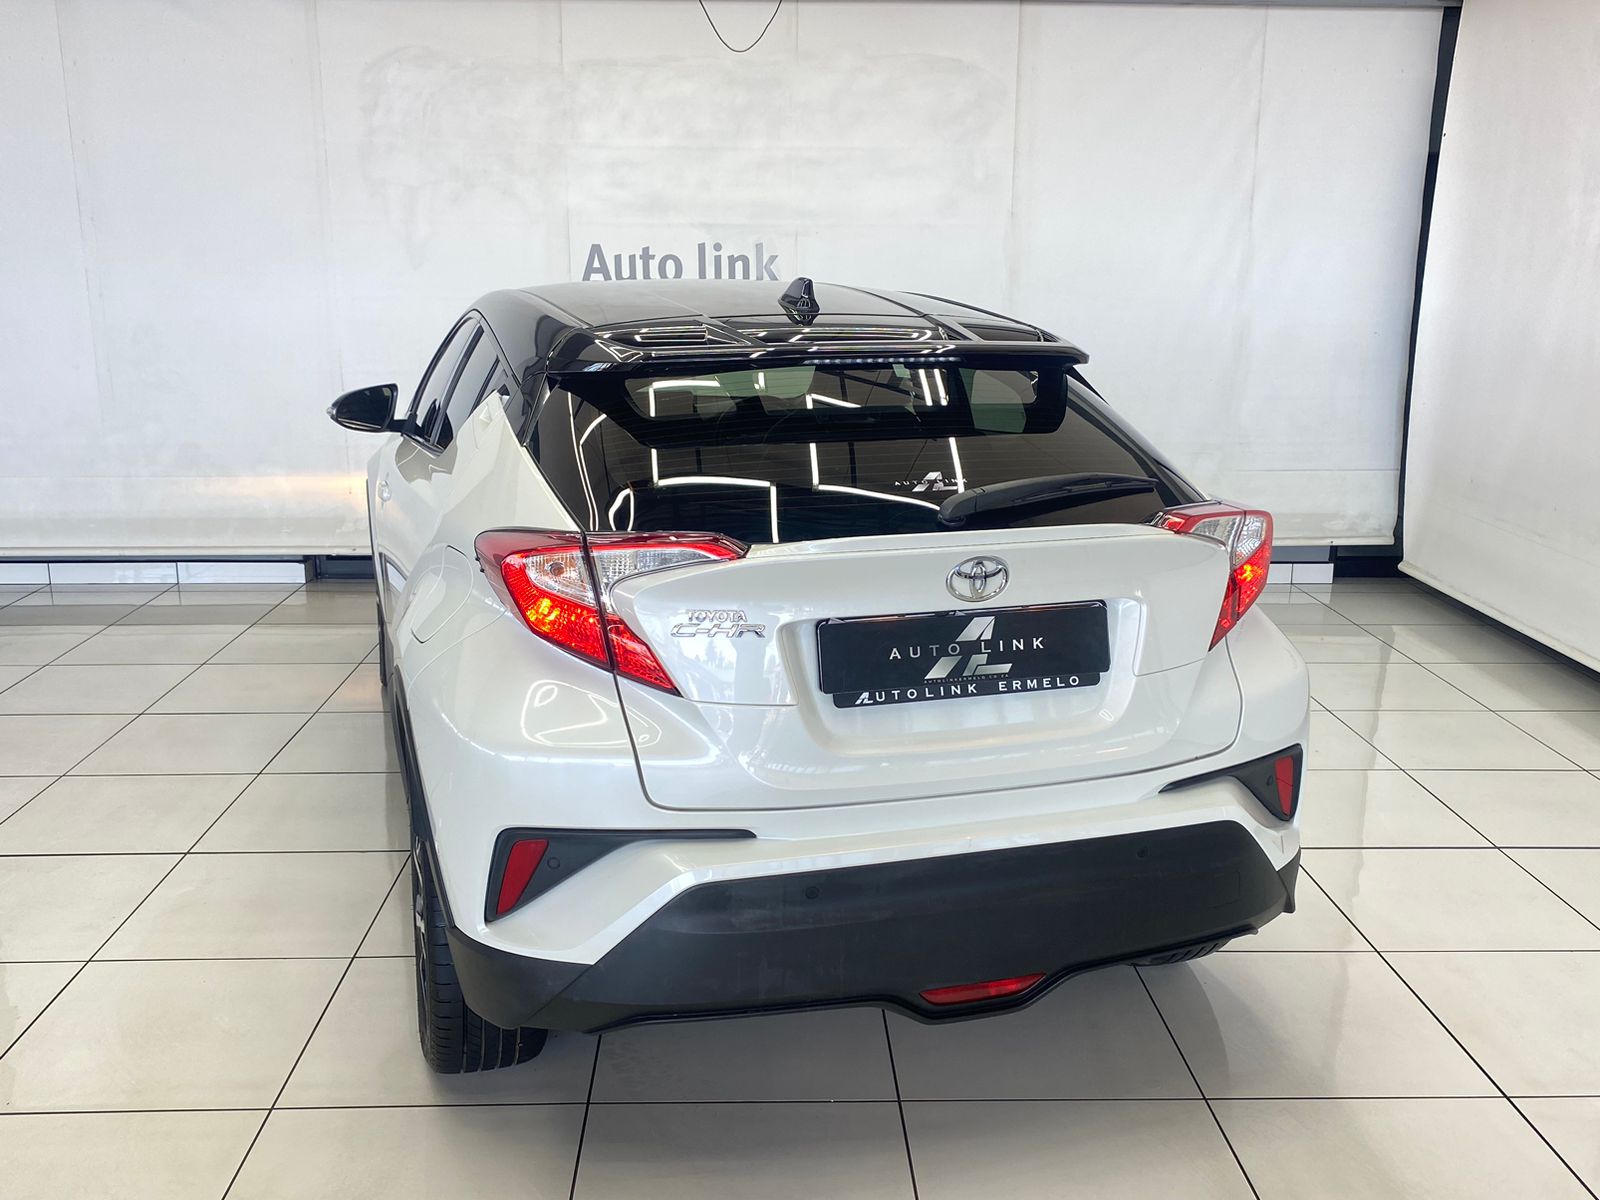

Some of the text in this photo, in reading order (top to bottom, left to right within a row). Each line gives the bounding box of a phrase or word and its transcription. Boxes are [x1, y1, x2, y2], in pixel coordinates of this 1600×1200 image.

[582, 242, 780, 281] Auto link
[686, 609, 747, 622] TOYOTA
[670, 623, 765, 638] C-HR
[889, 637, 1045, 660] AUTO LINK
[998, 675, 1080, 691] ERMELO
